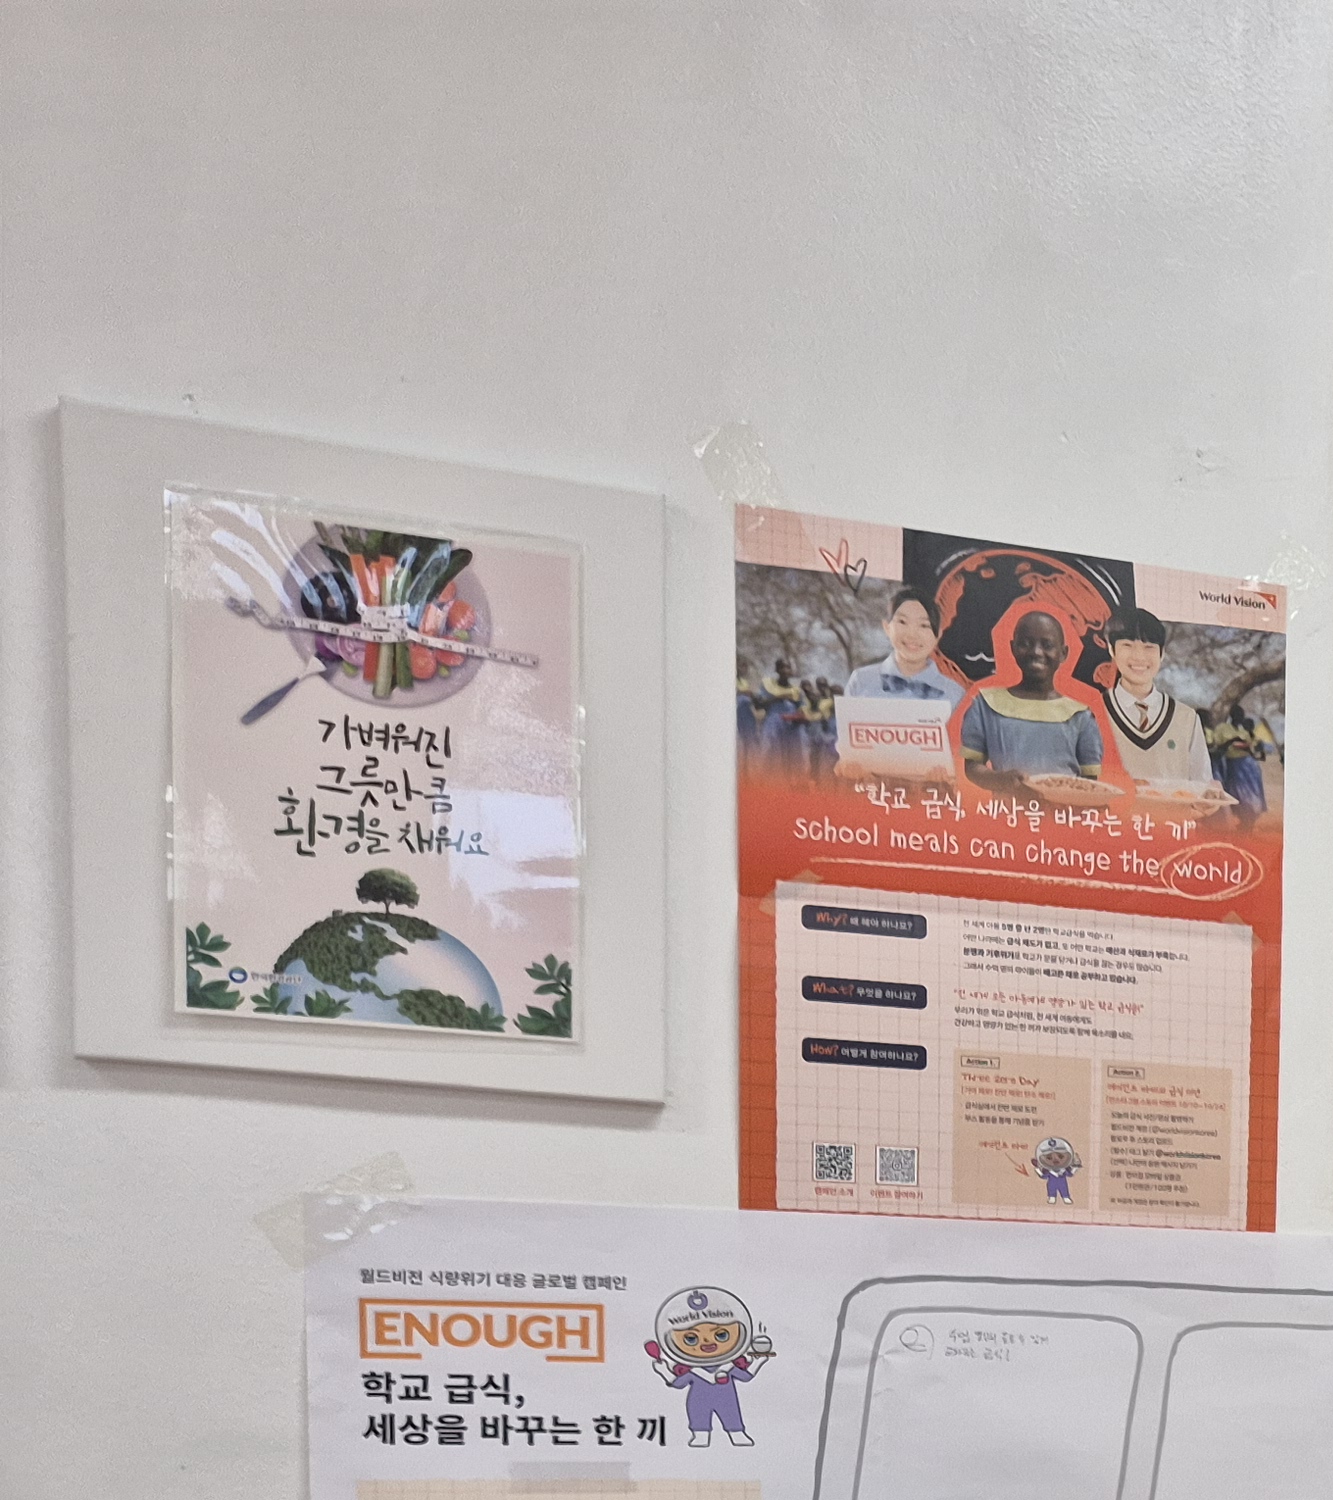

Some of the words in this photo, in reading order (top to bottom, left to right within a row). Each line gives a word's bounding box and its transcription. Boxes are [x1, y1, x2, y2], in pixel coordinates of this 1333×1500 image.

[1199, 590, 1231, 604] World
[1234, 595, 1265, 610] Vision
[317, 714, 451, 769] 가벼워진
[854, 728, 937, 745] ENOUGH
[316, 755, 453, 814] 그릇만큼
[274, 787, 391, 857] 환경을
[398, 822, 490, 855] 채워요
[976, 797, 1045, 832] 세상을
[1054, 808, 1122, 836] 바꾸는
[1132, 814, 1155, 840] 한
[793, 816, 879, 847] school
[890, 829, 959, 855] meals
[970, 836, 1015, 860] can
[1025, 839, 1111, 876] change
[1119, 849, 1160, 876] the
[1173, 860, 1242, 884] world
[816, 911, 848, 927] Why?
[881, 918, 913, 930] 하나요?
[885, 989, 917, 1001] 하나요?
[810, 1043, 839, 1056] How?
[360, 1268, 423, 1286] 월드비전
[429, 1270, 491, 1288] 식량위기
[496, 1272, 527, 1288] 대응
[532, 1273, 577, 1290] 글로벌
[583, 1274, 627, 1291] 캠페인
[374, 1311, 590, 1350] ENOUGH
[668, 1312, 700, 1325] World
[702, 1310, 734, 1319] Vision
[361, 1371, 432, 1404] 학교
[444, 1373, 525, 1408] 급식,
[363, 1413, 468, 1446] 세상을
[480, 1414, 582, 1446] 바꾸는
[592, 1414, 626, 1446] 한
[637, 1415, 667, 1447] 끼
